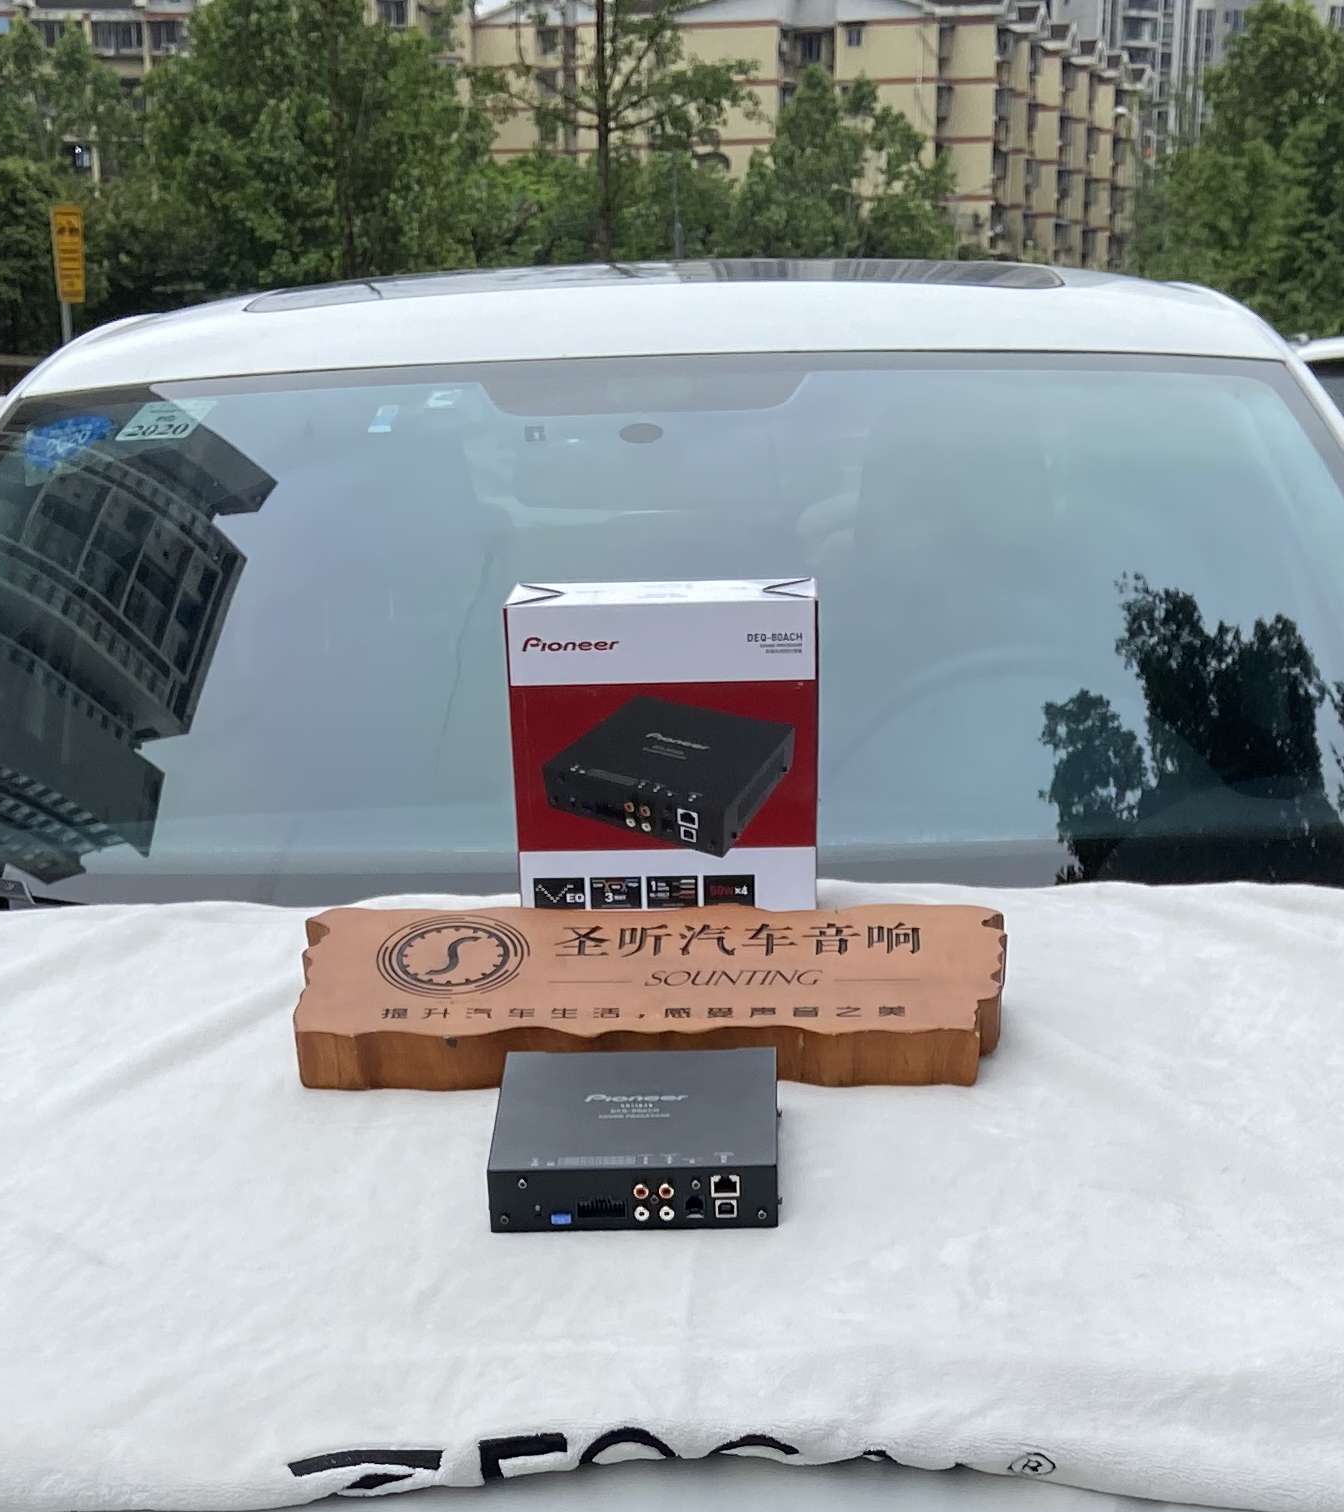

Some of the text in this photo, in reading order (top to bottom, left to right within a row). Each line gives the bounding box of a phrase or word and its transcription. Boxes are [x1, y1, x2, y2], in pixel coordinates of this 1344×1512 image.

[126, 423, 190, 437] 2020
[522, 636, 619, 652] Pioneer
[554, 922, 921, 957] 圣听汽车音响
[644, 969, 824, 986] SOUNTING
